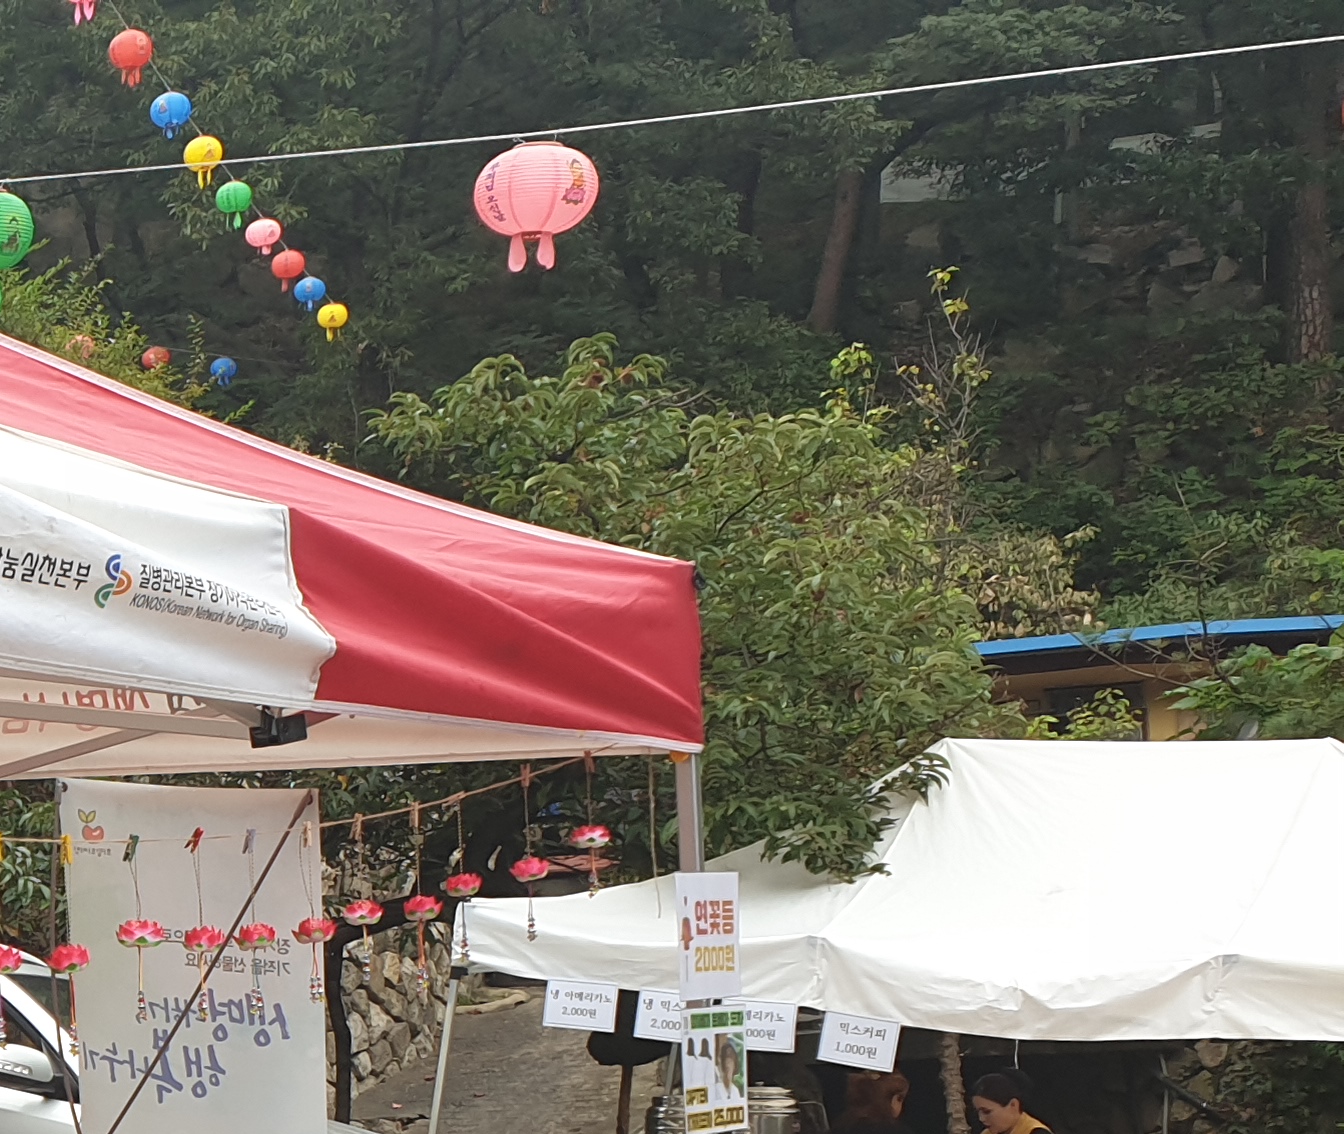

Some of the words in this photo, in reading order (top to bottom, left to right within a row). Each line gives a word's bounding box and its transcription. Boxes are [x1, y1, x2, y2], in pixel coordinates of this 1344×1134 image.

[139, 564, 207, 601] 질병관리본부
[193, 605, 226, 624] Network
[694, 900, 735, 936] 연꽃등
[694, 944, 736, 973] 2000원
[840, 1021, 887, 1041] 믹스커피
